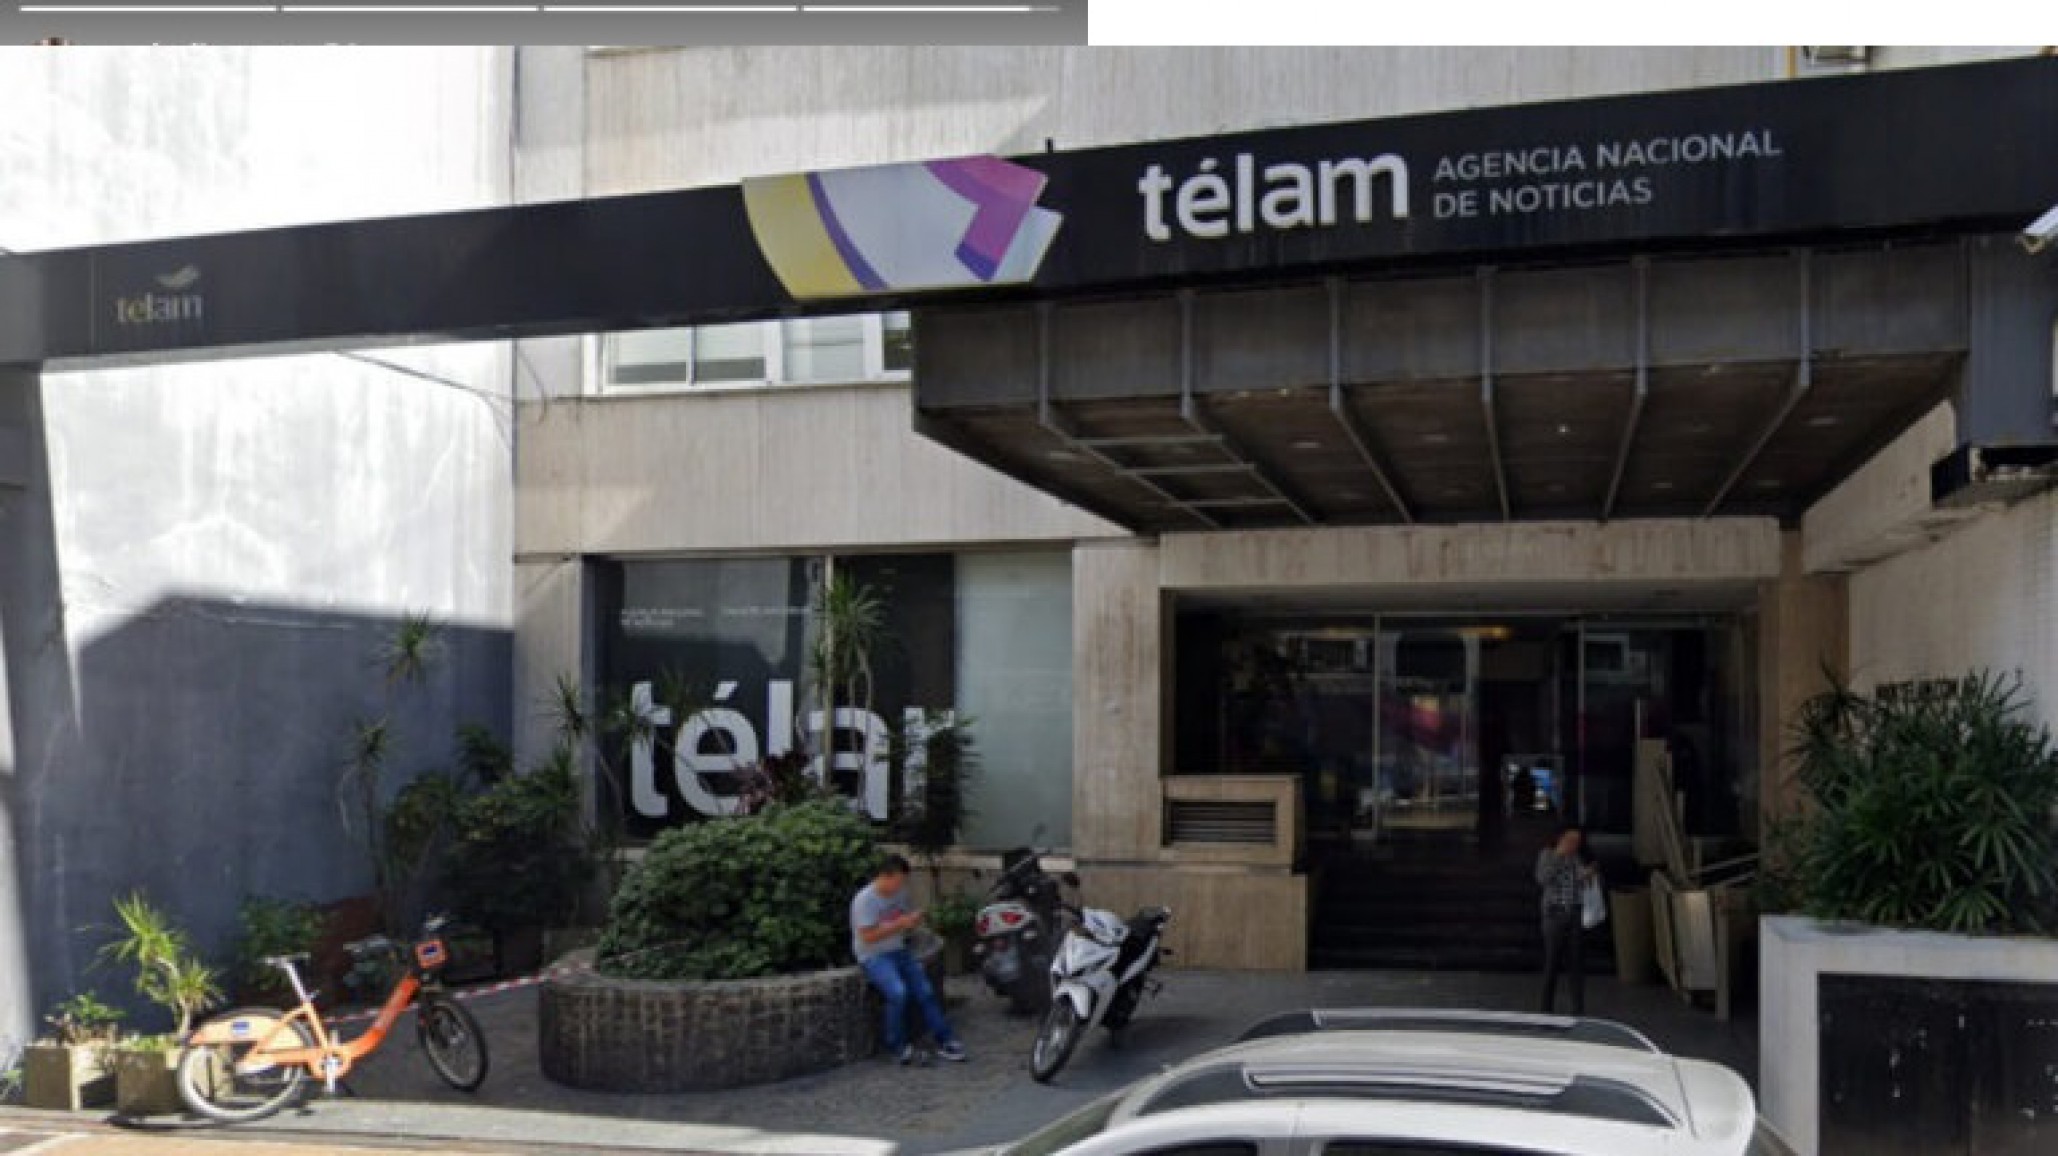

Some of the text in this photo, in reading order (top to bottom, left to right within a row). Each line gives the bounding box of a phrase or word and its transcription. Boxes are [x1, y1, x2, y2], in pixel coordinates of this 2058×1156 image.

[1433, 129, 1784, 182] AGENCIA NACIONAL
[1138, 152, 1410, 241] télam
[1433, 176, 1653, 219] DE NOTICIAS
